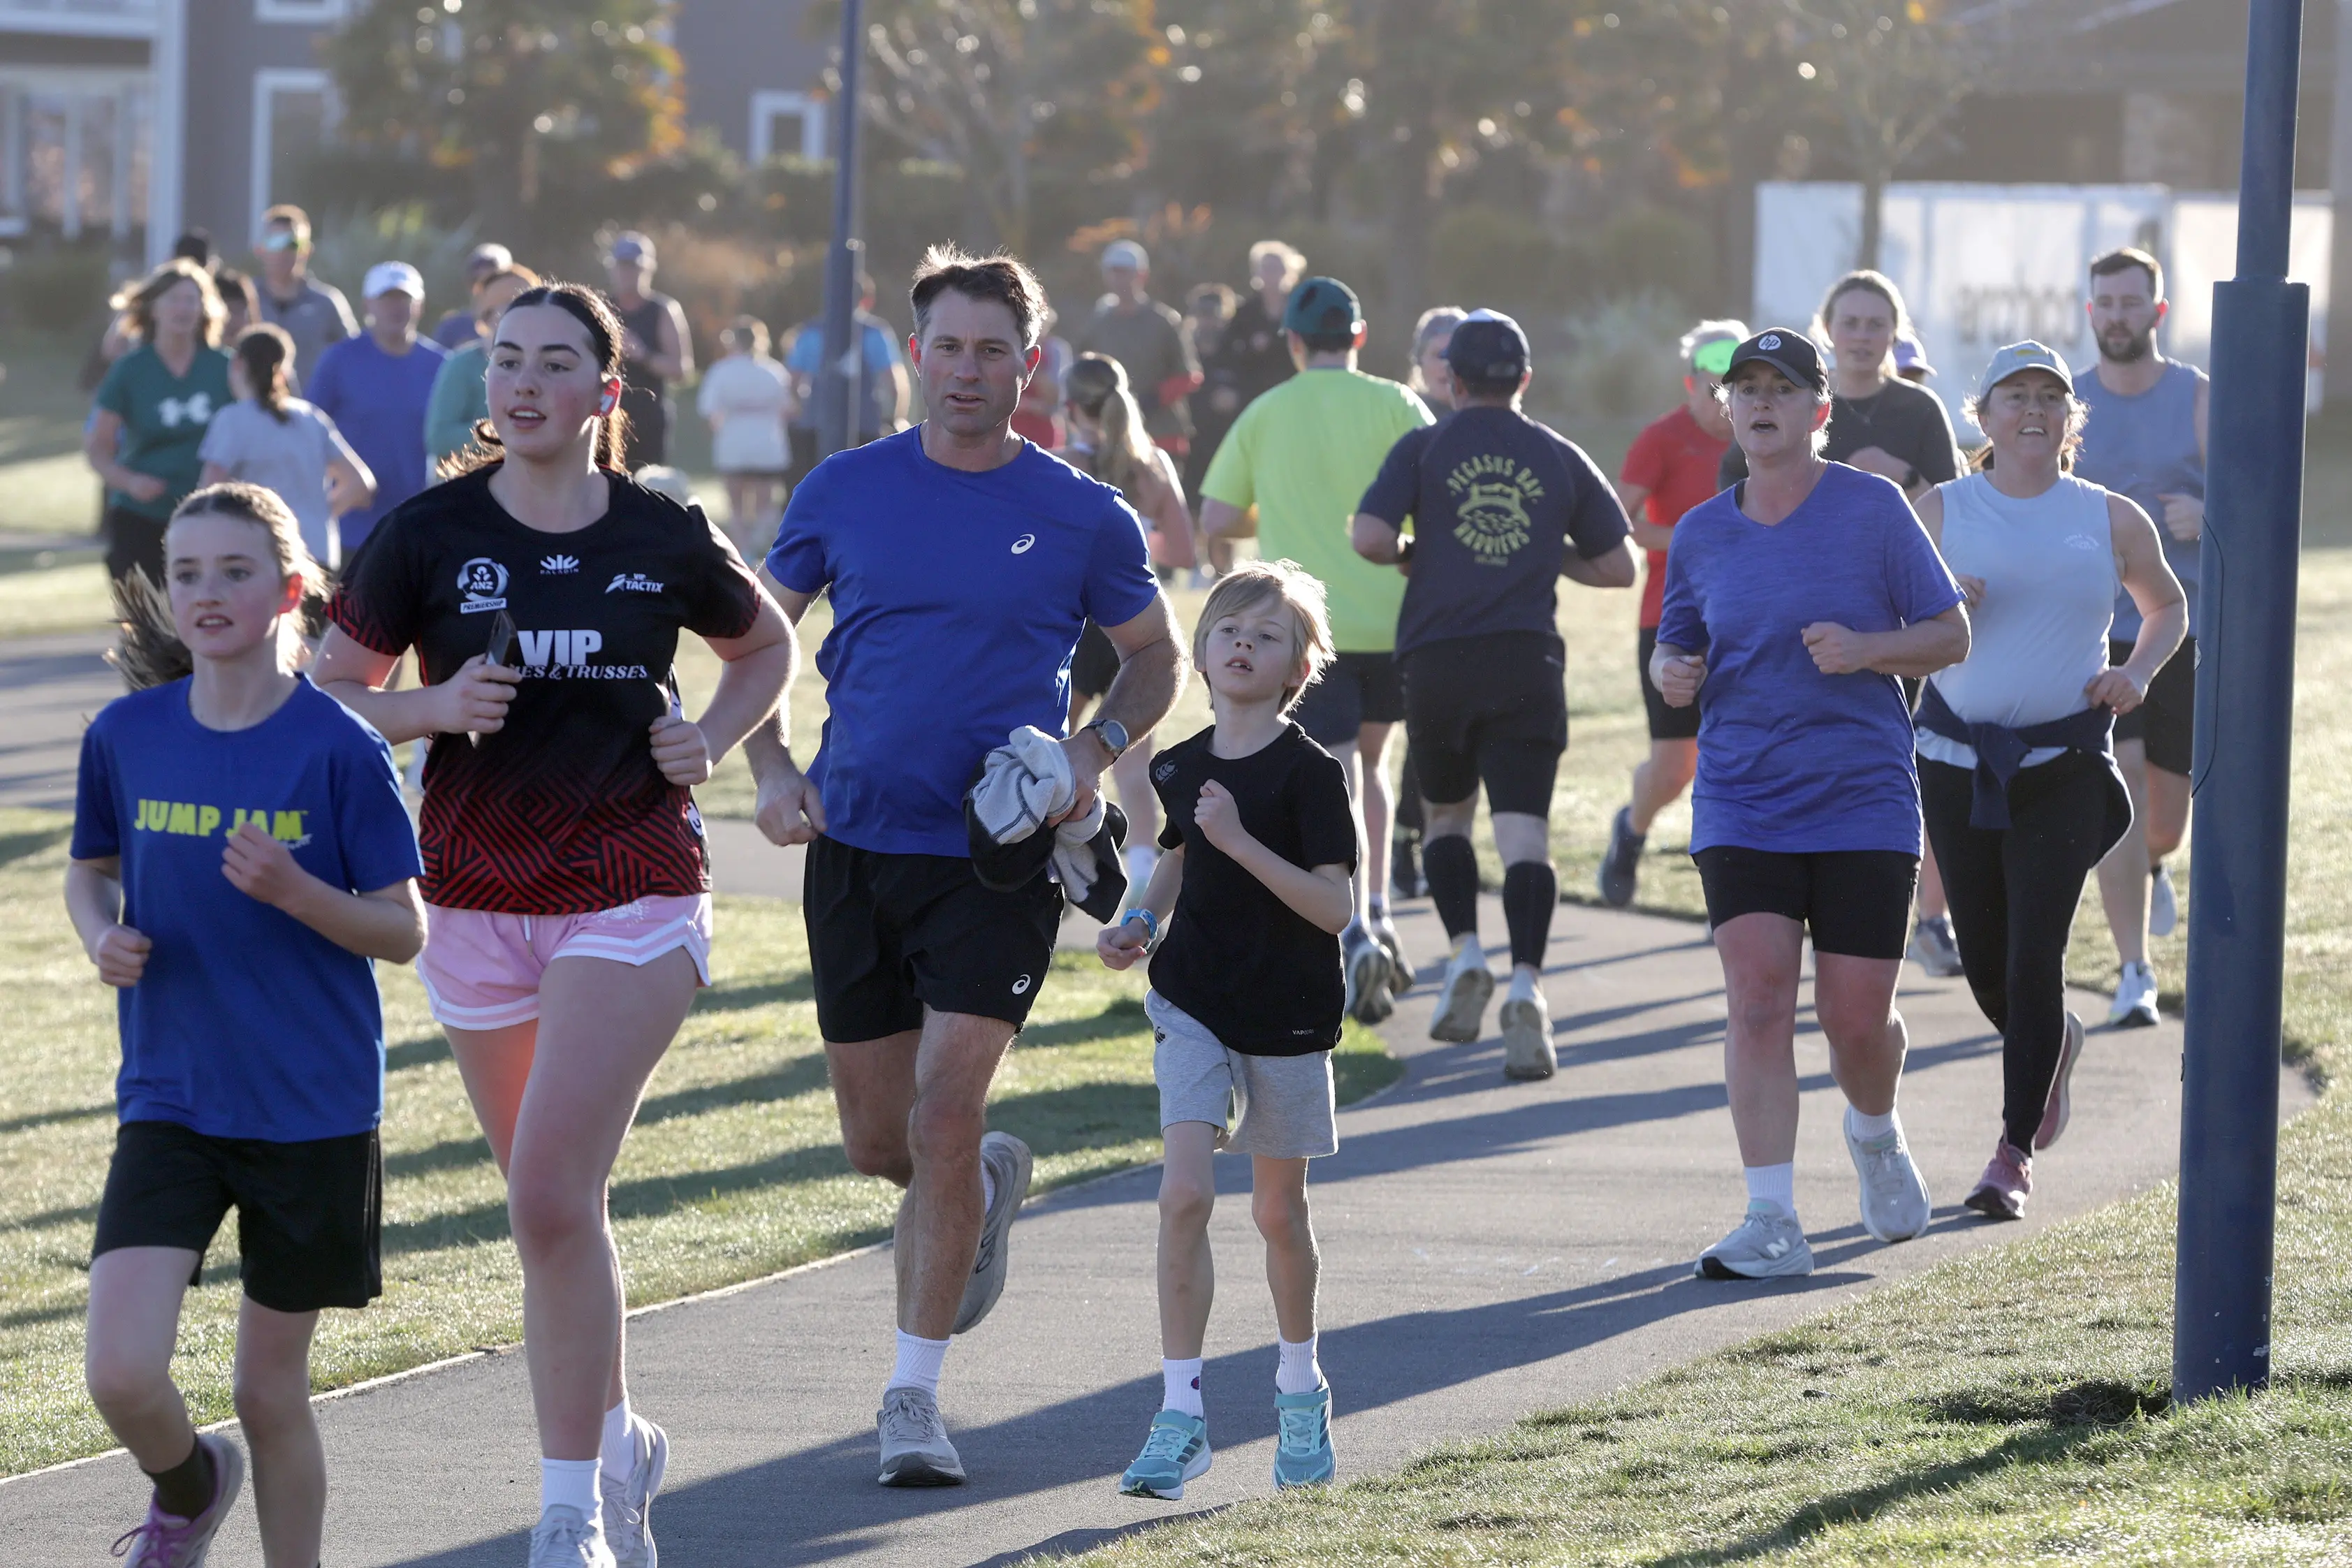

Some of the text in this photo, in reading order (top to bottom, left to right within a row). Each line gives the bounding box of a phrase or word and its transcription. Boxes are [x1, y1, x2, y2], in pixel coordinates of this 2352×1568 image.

[1760, 335, 1779, 351] hp
[1446, 454, 1546, 497] PEGASUS BAY
[1453, 520, 1531, 555] HARRIERS
[540, 567, 580, 576] PALADIN
[633, 573, 647, 581] VIP
[469, 580, 494, 591] ANZ
[625, 580, 665, 594] TACTIX
[462, 599, 504, 612] PREMIERSHIP
[518, 629, 603, 666] VIP
[548, 662, 563, 680] &
[564, 664, 648, 680] TRUSSES
[133, 798, 221, 837] JUMP
